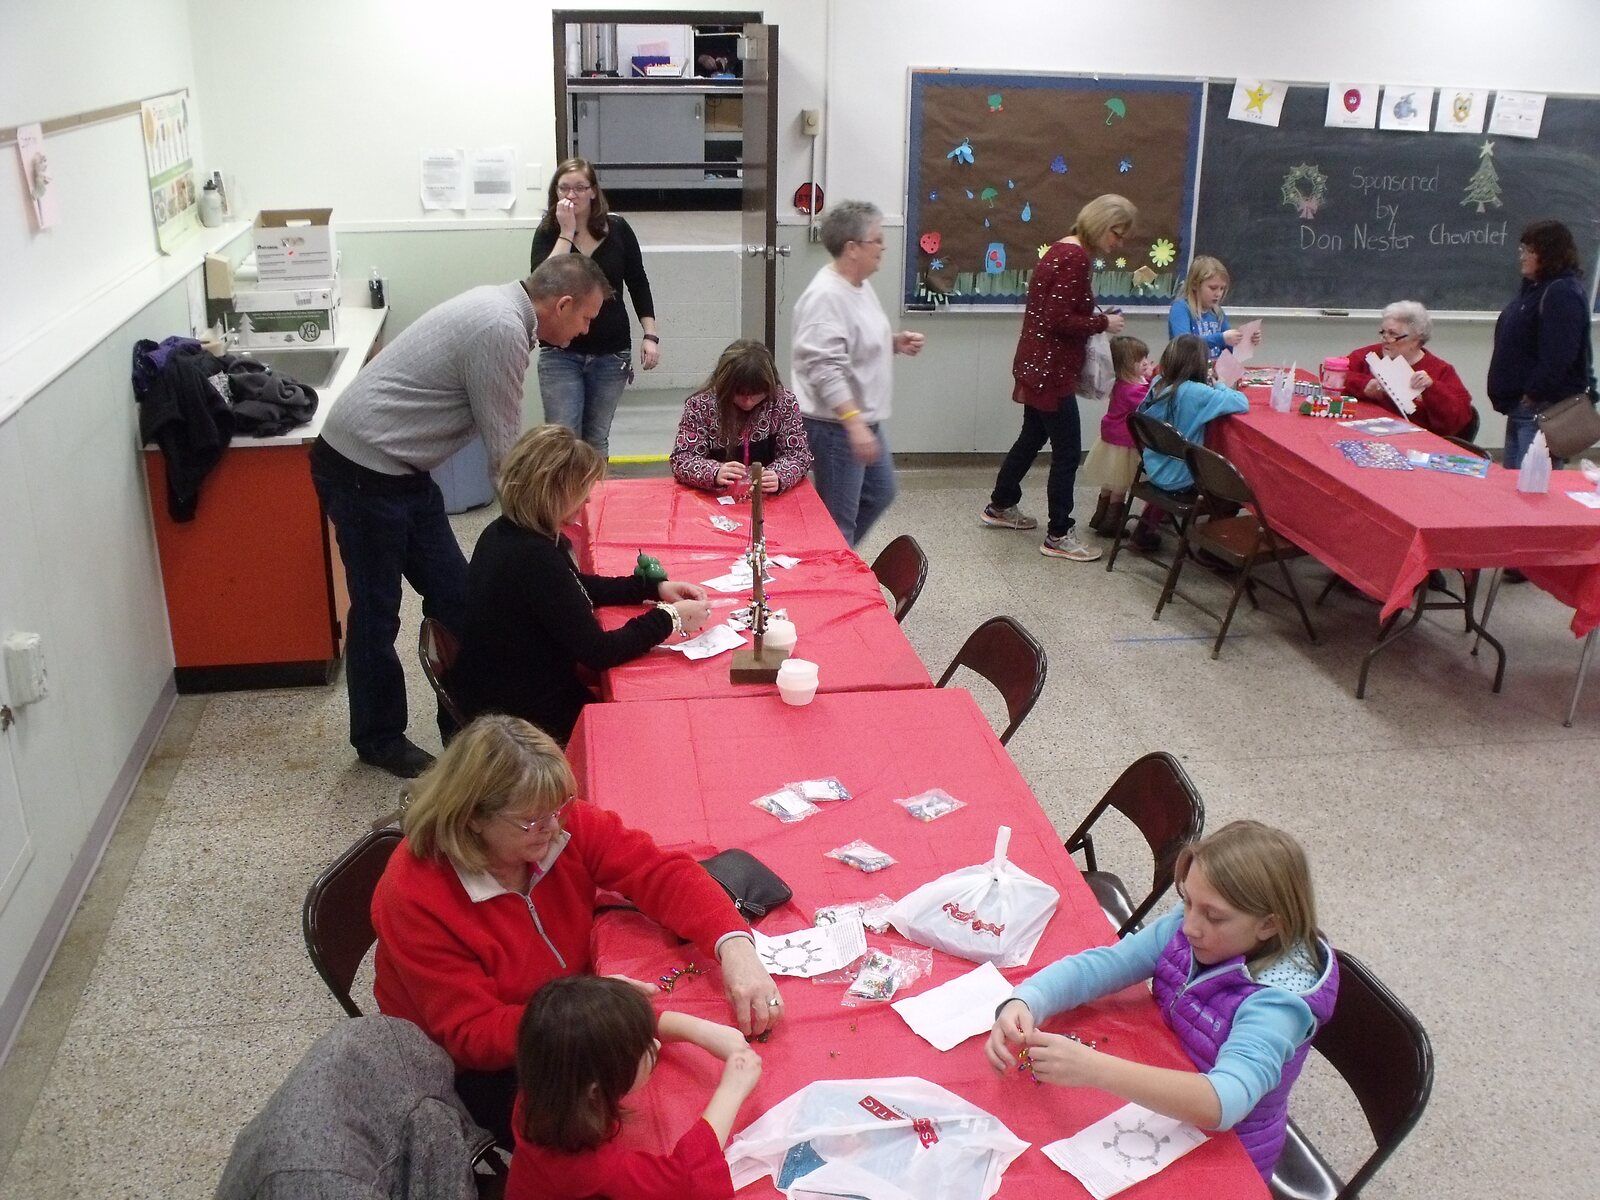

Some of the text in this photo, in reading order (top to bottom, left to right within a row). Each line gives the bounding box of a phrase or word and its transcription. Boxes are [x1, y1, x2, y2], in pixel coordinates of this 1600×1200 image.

[1351, 165, 1440, 195] Sponsored
[1376, 195, 1399, 231] by
[1300, 220, 1508, 251] Don Nester Chevrolet
